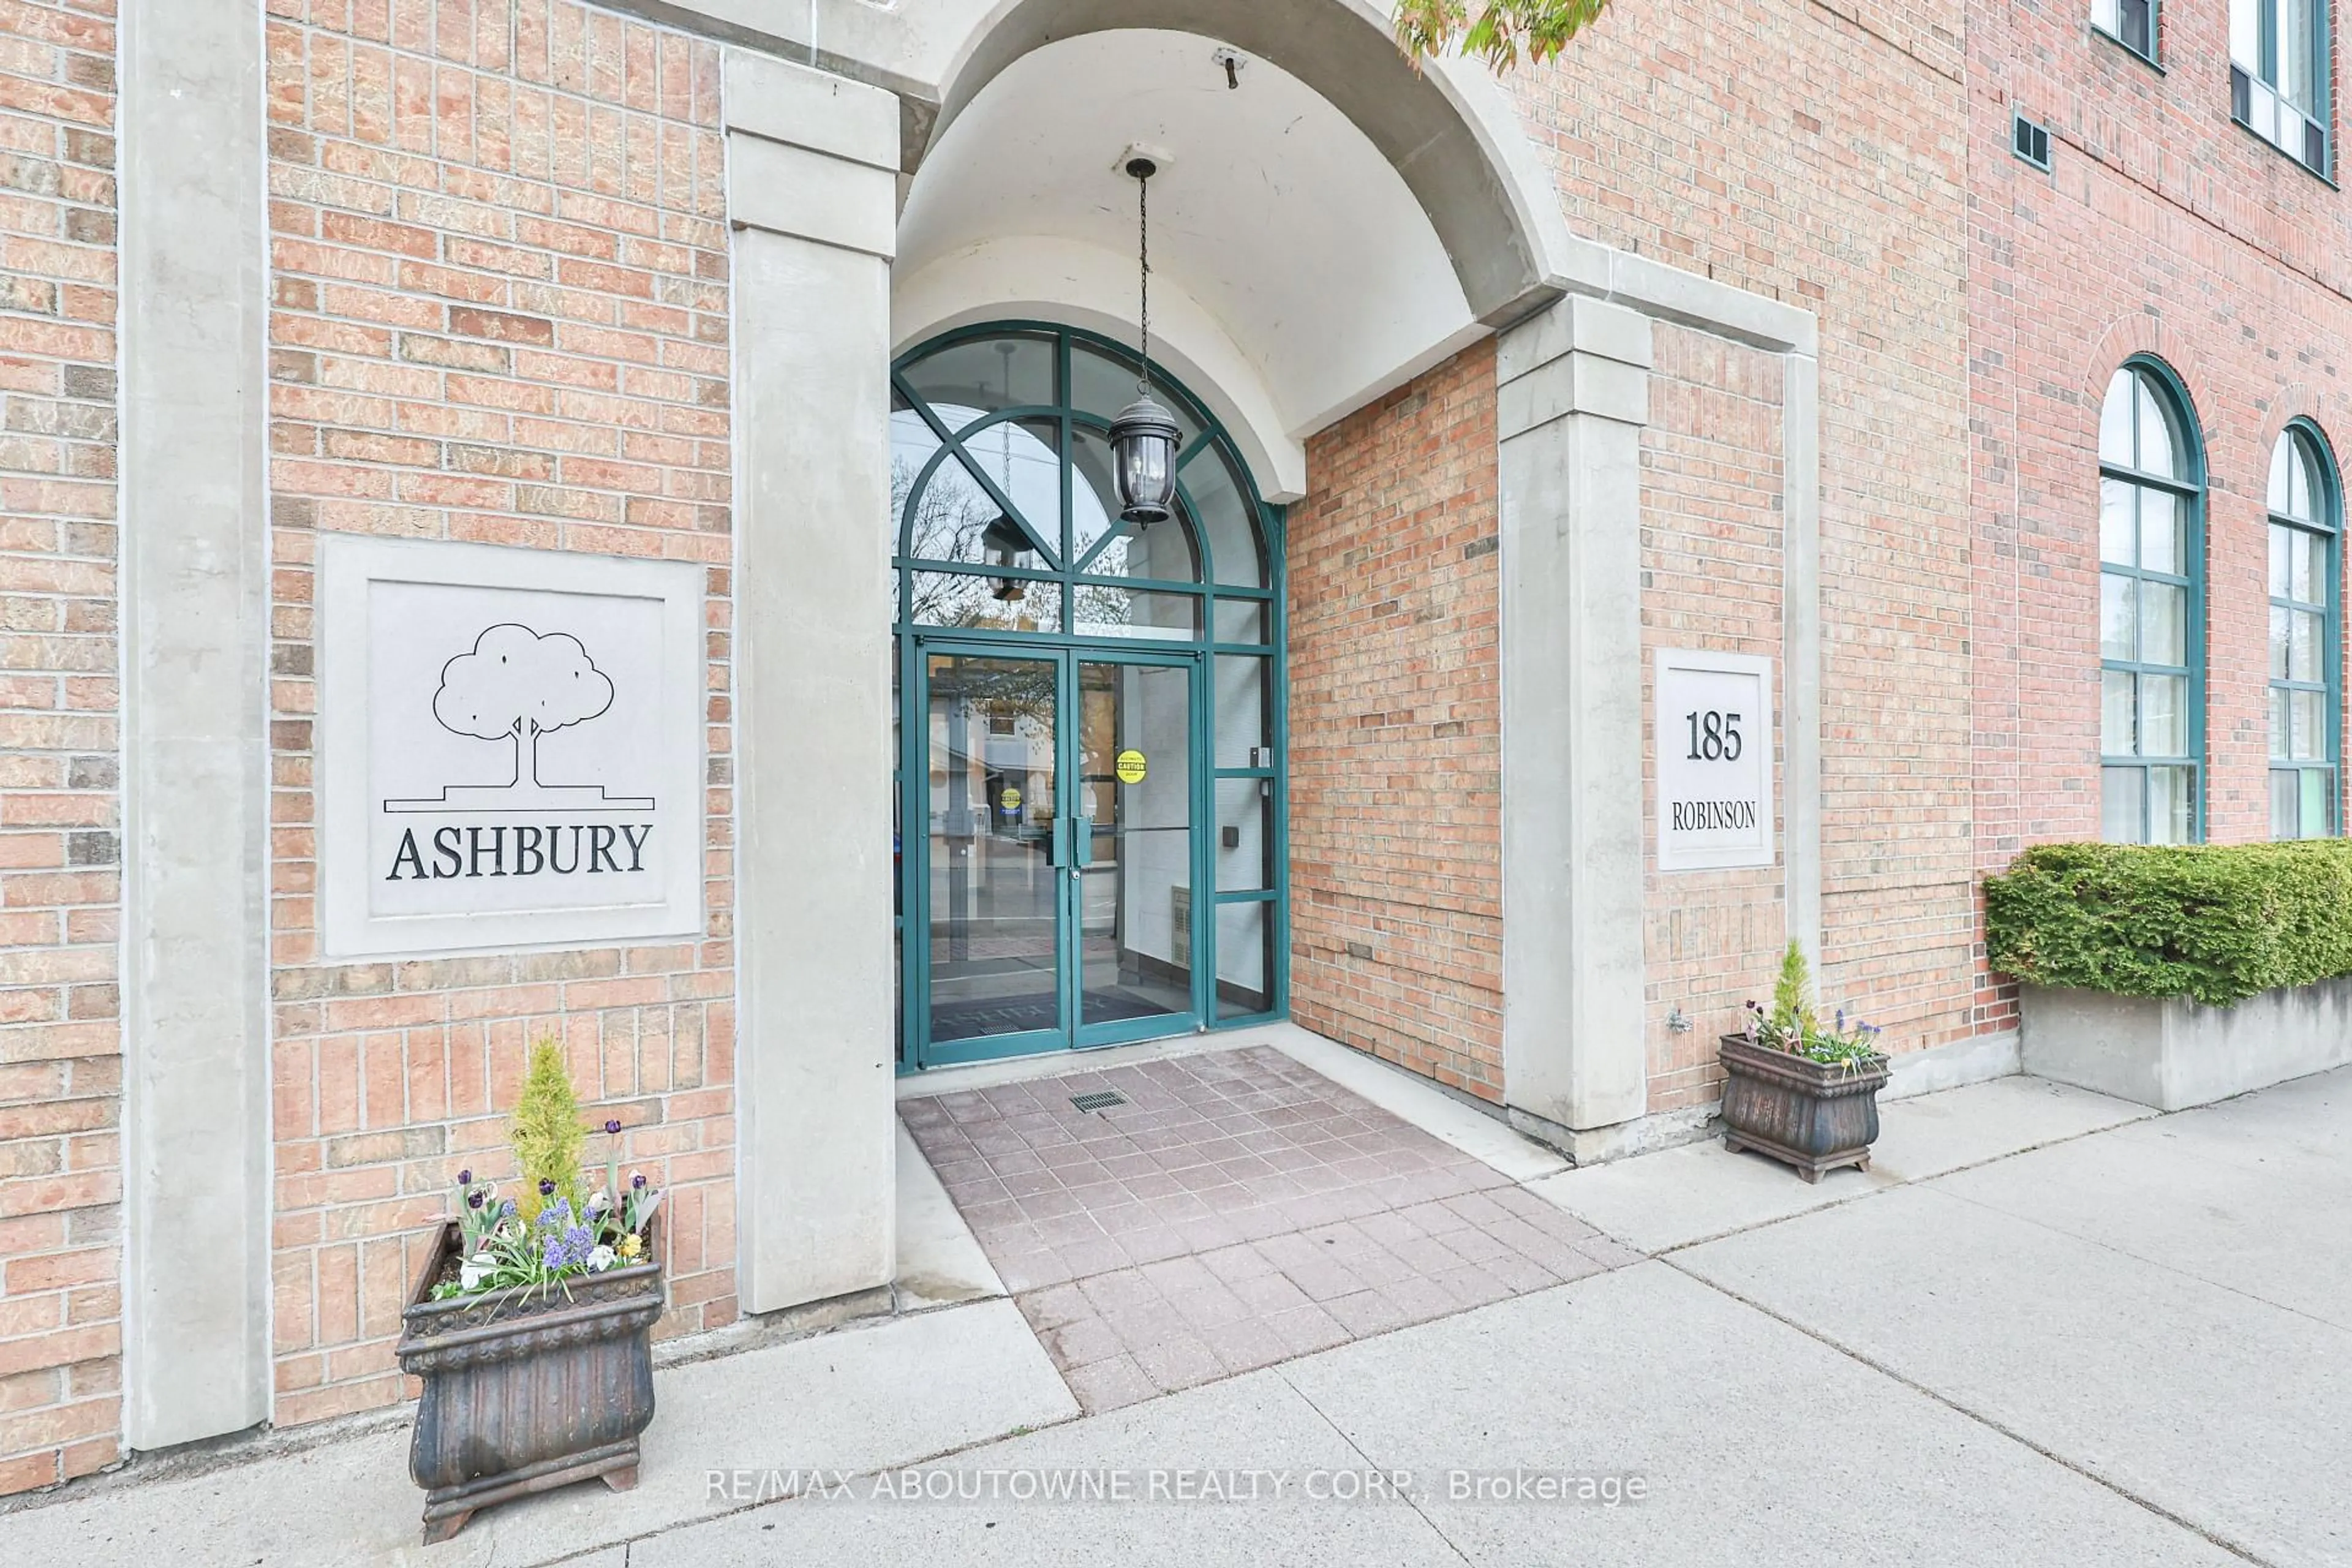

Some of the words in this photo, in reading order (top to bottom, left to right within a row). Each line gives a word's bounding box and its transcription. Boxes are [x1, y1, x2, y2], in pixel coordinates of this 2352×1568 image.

[1686, 710, 1742, 762] 185
[1672, 801, 1756, 831] ROBINSON
[385, 824, 654, 881] ASHBURY
